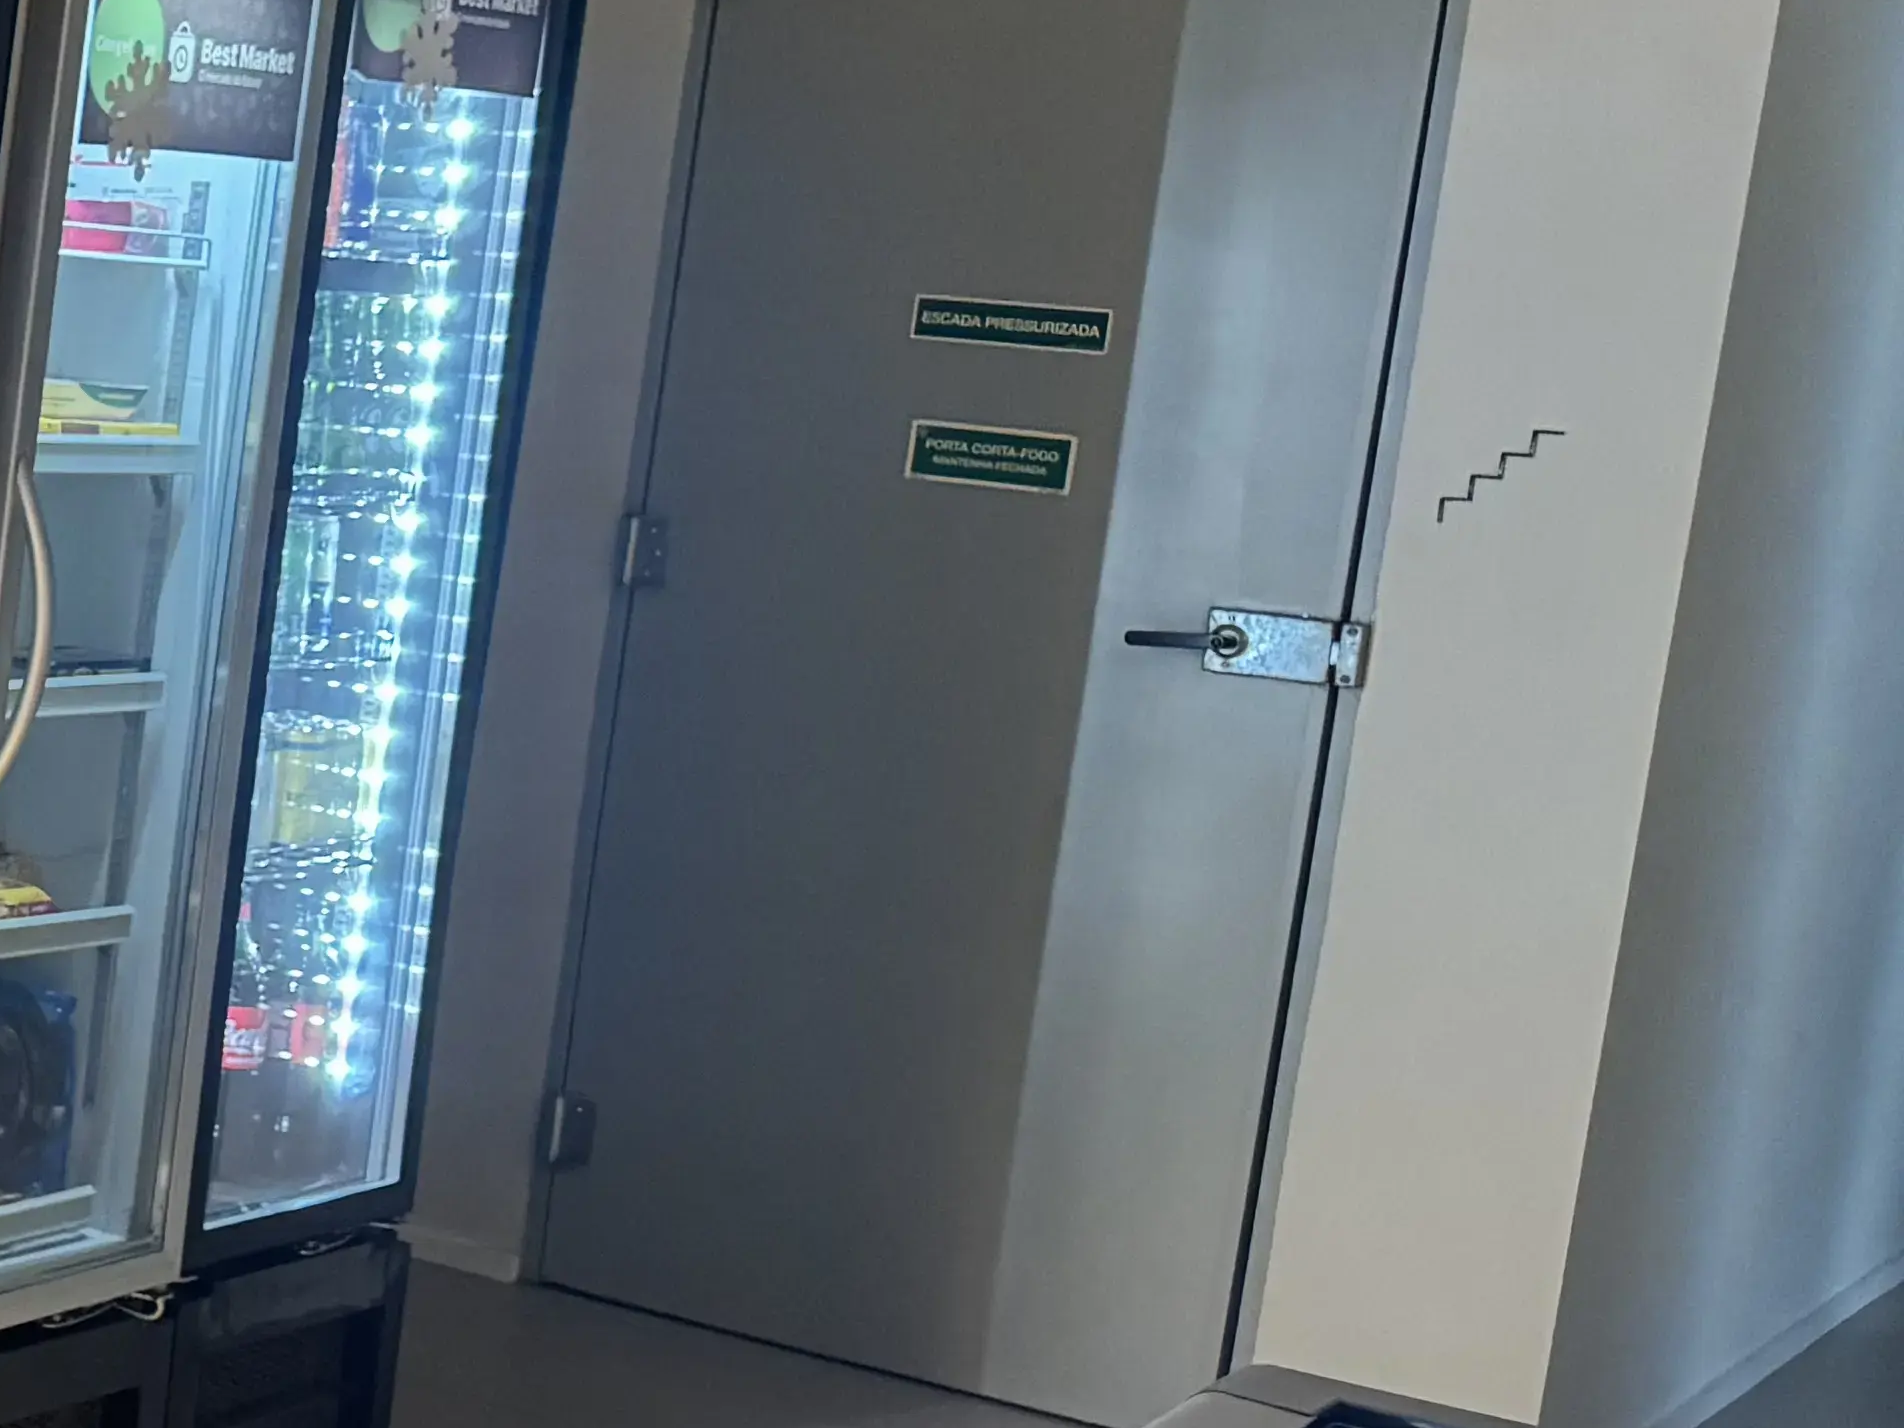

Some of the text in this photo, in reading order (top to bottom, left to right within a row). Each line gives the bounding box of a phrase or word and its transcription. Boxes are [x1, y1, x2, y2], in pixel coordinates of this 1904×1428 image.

[200, 38, 295, 76] Best Market
[922, 310, 1100, 339] ESCADA PRESSURIZADA
[926, 439, 968, 453] PORTA
